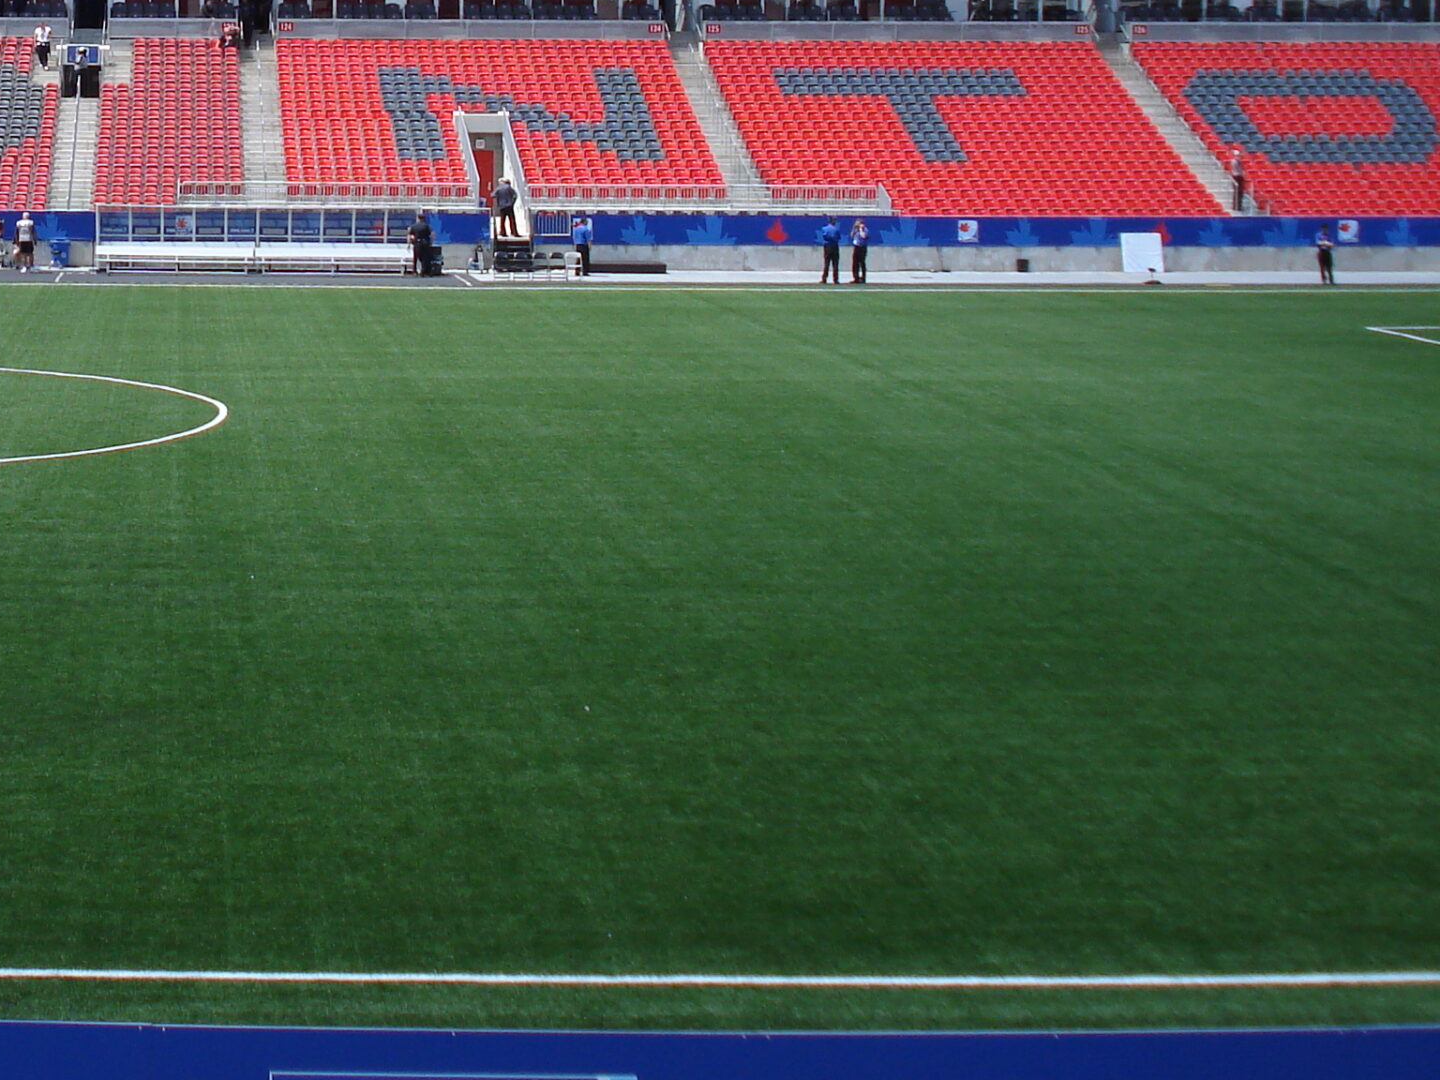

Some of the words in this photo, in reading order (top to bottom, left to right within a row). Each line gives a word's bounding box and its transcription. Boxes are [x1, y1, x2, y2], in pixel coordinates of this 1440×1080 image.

[280, 22, 293, 31] 124
[649, 24, 662, 33] 124
[708, 24, 720, 33] 125
